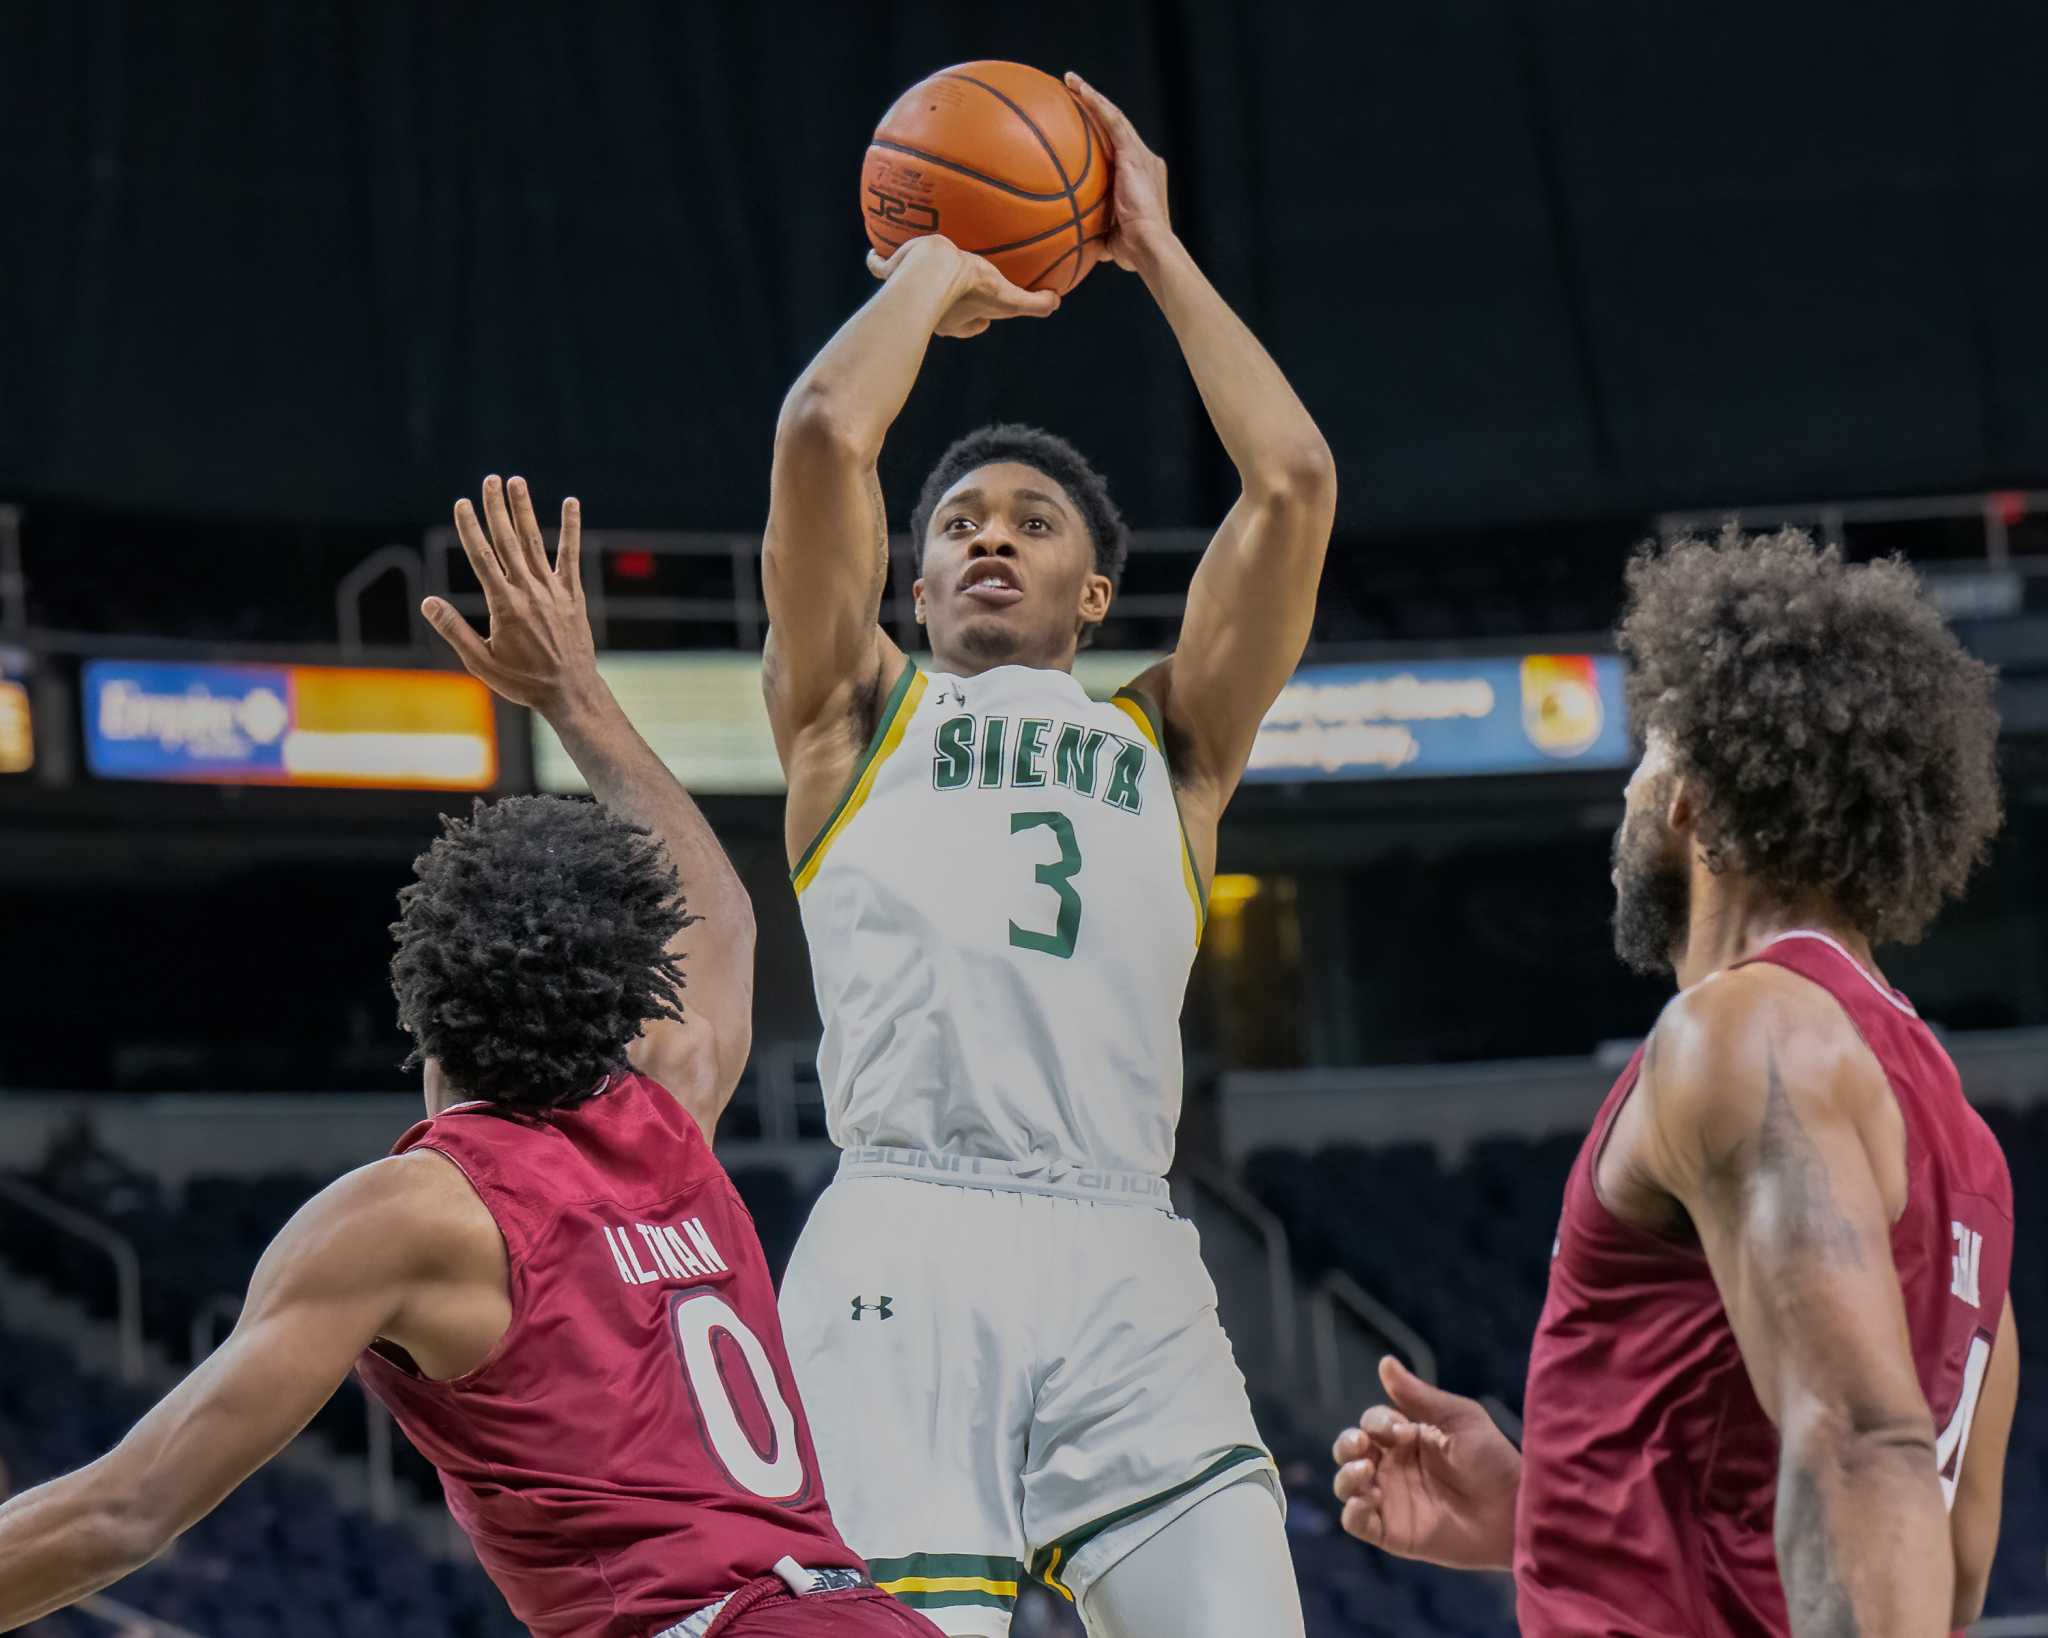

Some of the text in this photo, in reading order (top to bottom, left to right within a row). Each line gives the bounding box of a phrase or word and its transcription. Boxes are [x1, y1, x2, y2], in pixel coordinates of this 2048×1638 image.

[932, 713, 1146, 815] SIENA
[1008, 811, 1083, 960] 3
[672, 1289, 808, 1503] 0
